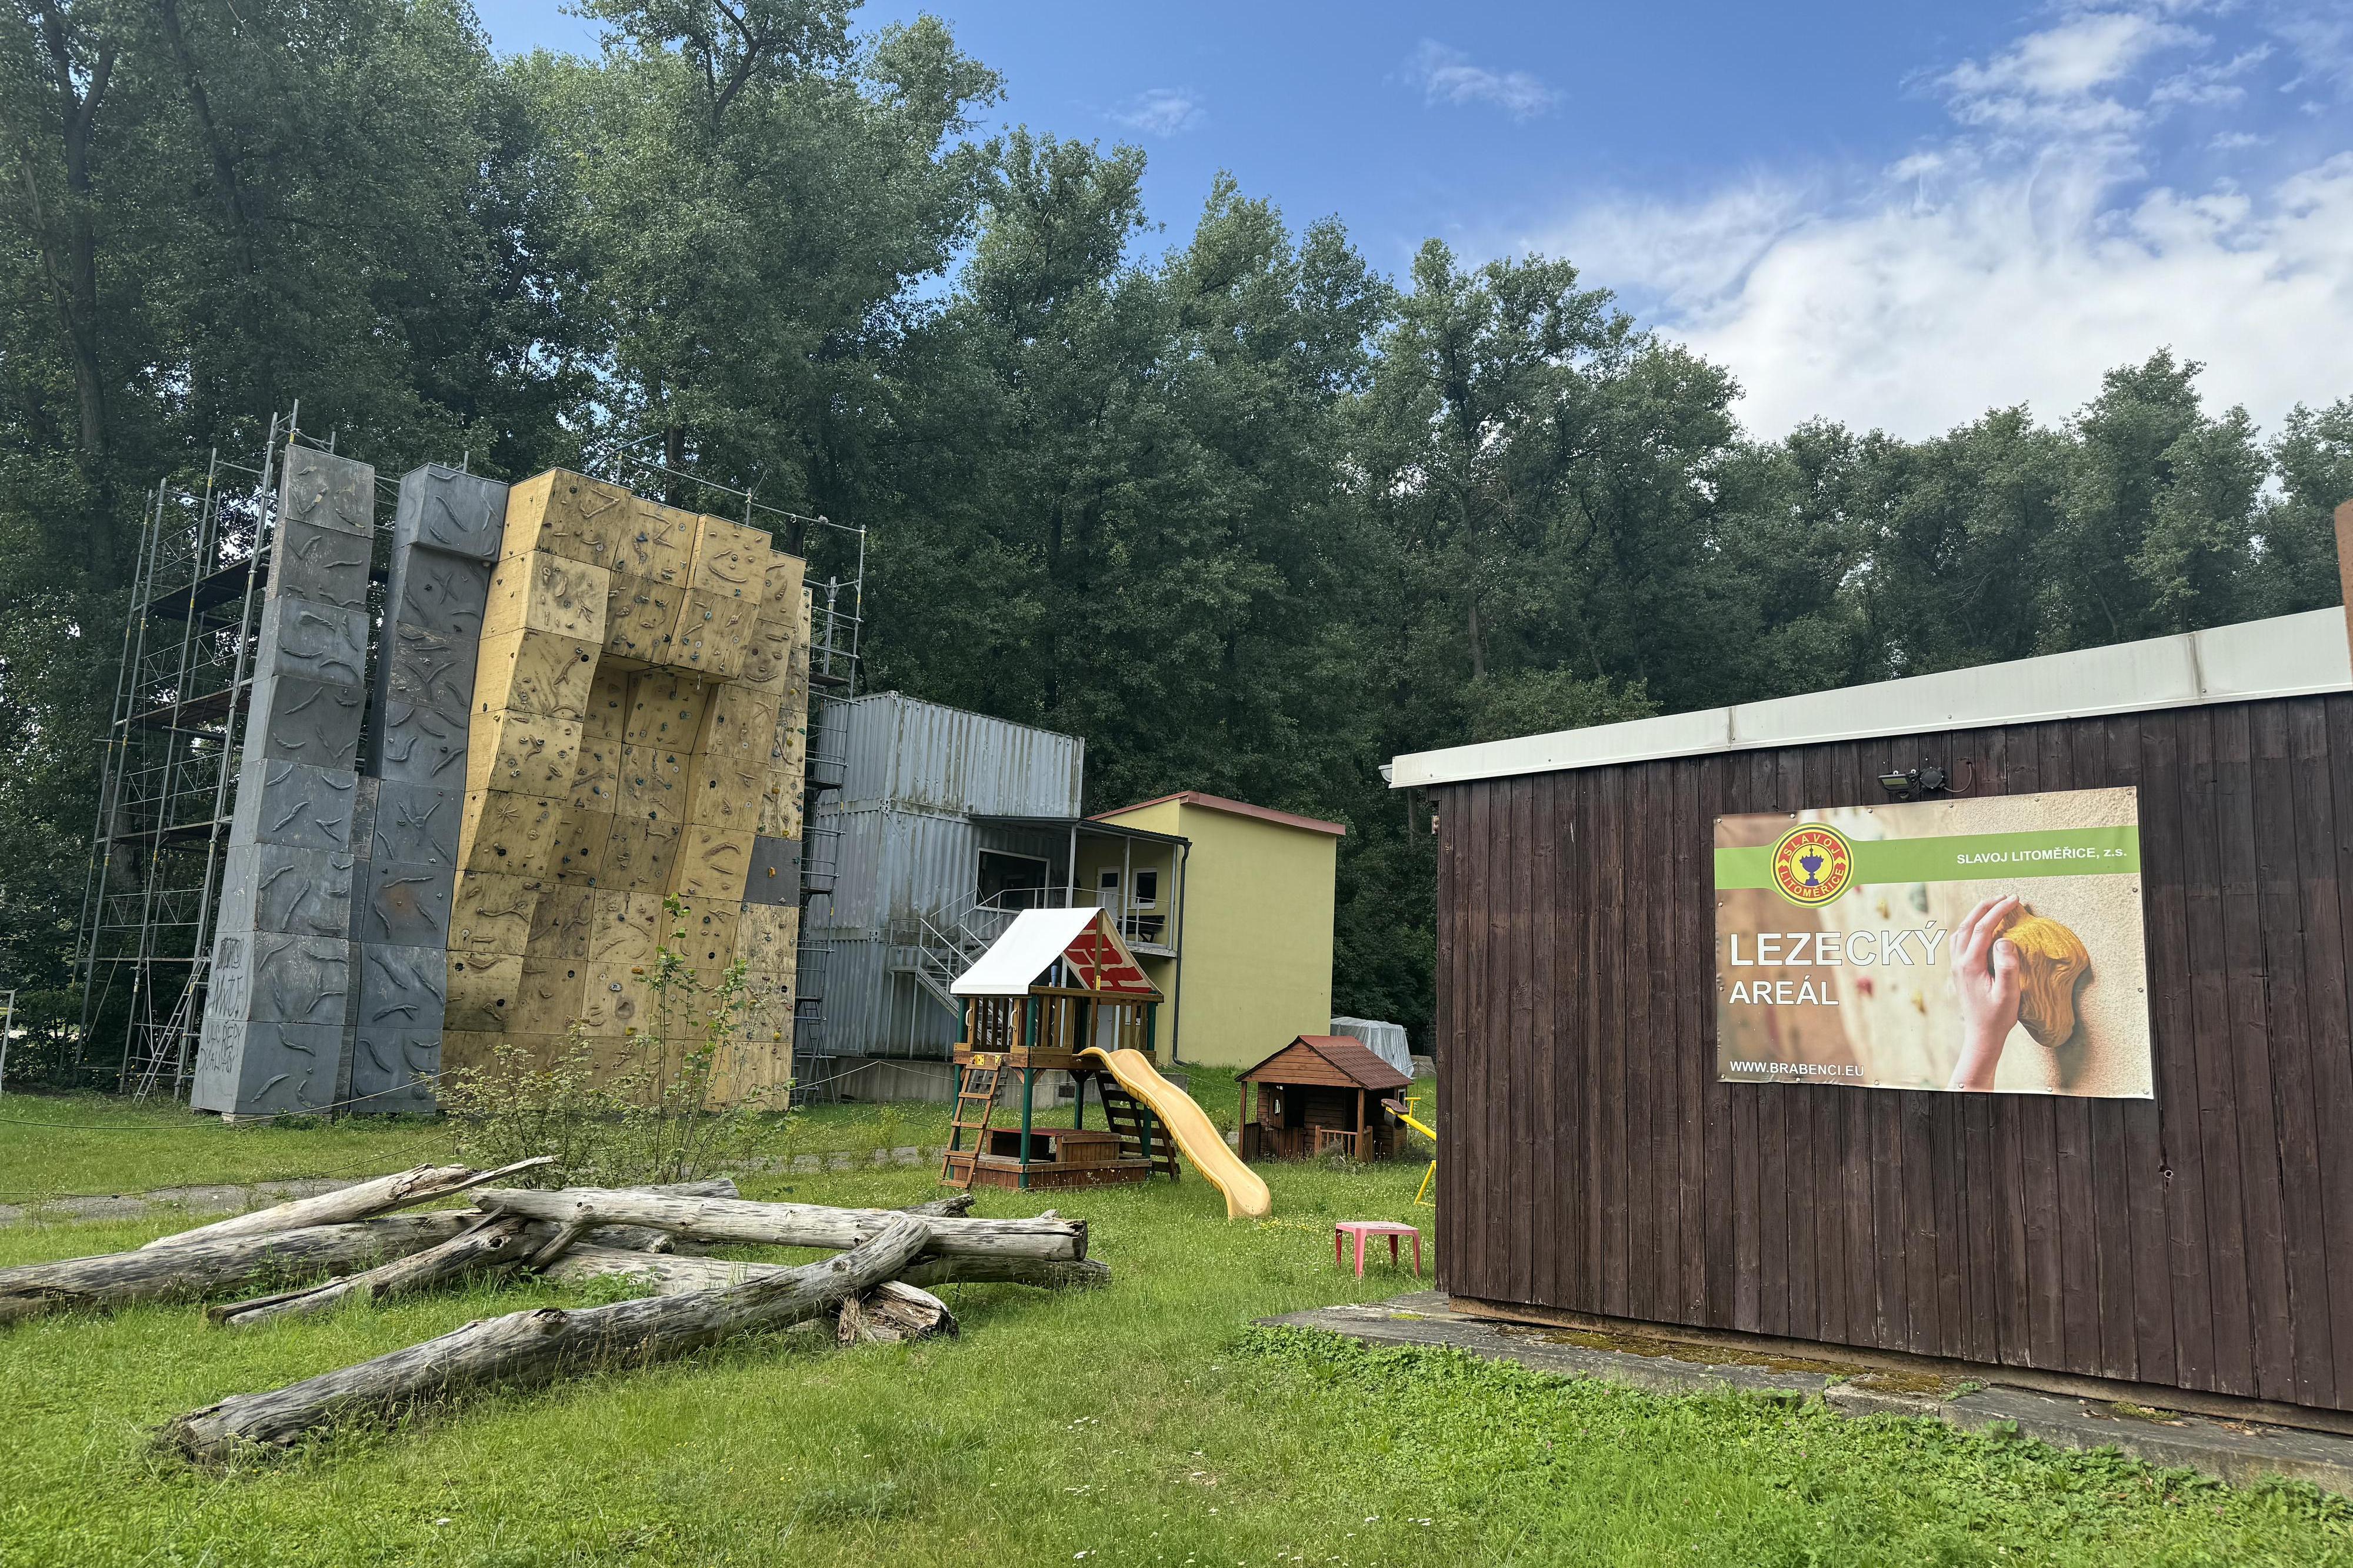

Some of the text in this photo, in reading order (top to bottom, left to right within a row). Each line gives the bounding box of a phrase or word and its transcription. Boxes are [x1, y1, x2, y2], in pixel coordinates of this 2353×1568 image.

[1783, 833, 1840, 856] SLAVOJ
[1957, 846, 2127, 865] SLAVOJ LITOMĚŘICE, z.s.
[1780, 868, 1844, 898] LITOMĚŘICE
[1730, 920, 1947, 966] LEZECKÝ
[1729, 975, 1839, 1006] AREÁL
[1729, 1060, 1865, 1077] WWW.BRABENCI.EU
